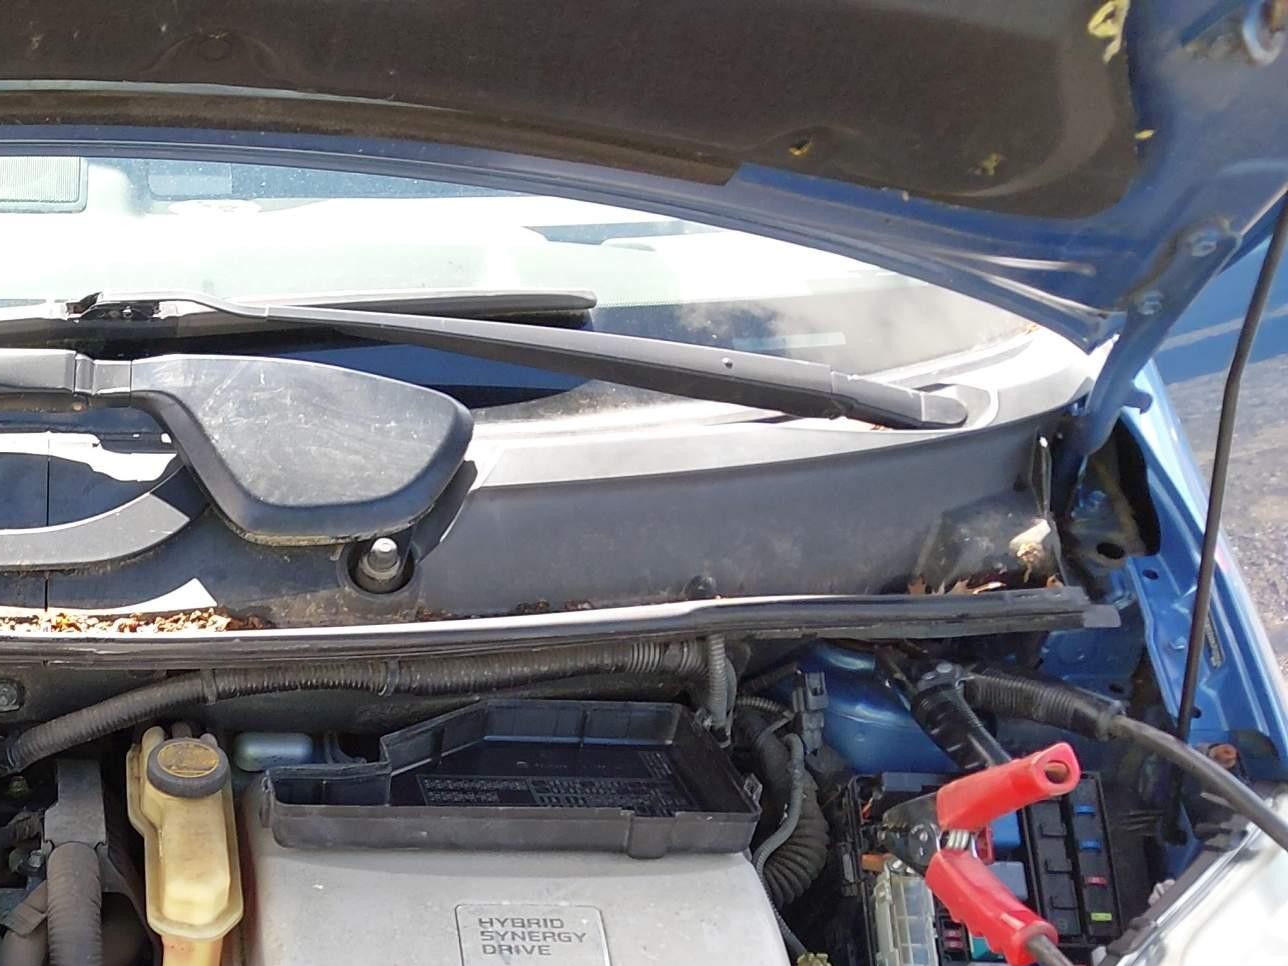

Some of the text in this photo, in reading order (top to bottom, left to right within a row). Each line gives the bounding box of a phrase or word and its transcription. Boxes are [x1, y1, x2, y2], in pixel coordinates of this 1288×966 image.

[478, 917, 565, 929] HYBRID
[480, 930, 587, 943] SYNERGY
[482, 943, 552, 956] DRIVE
